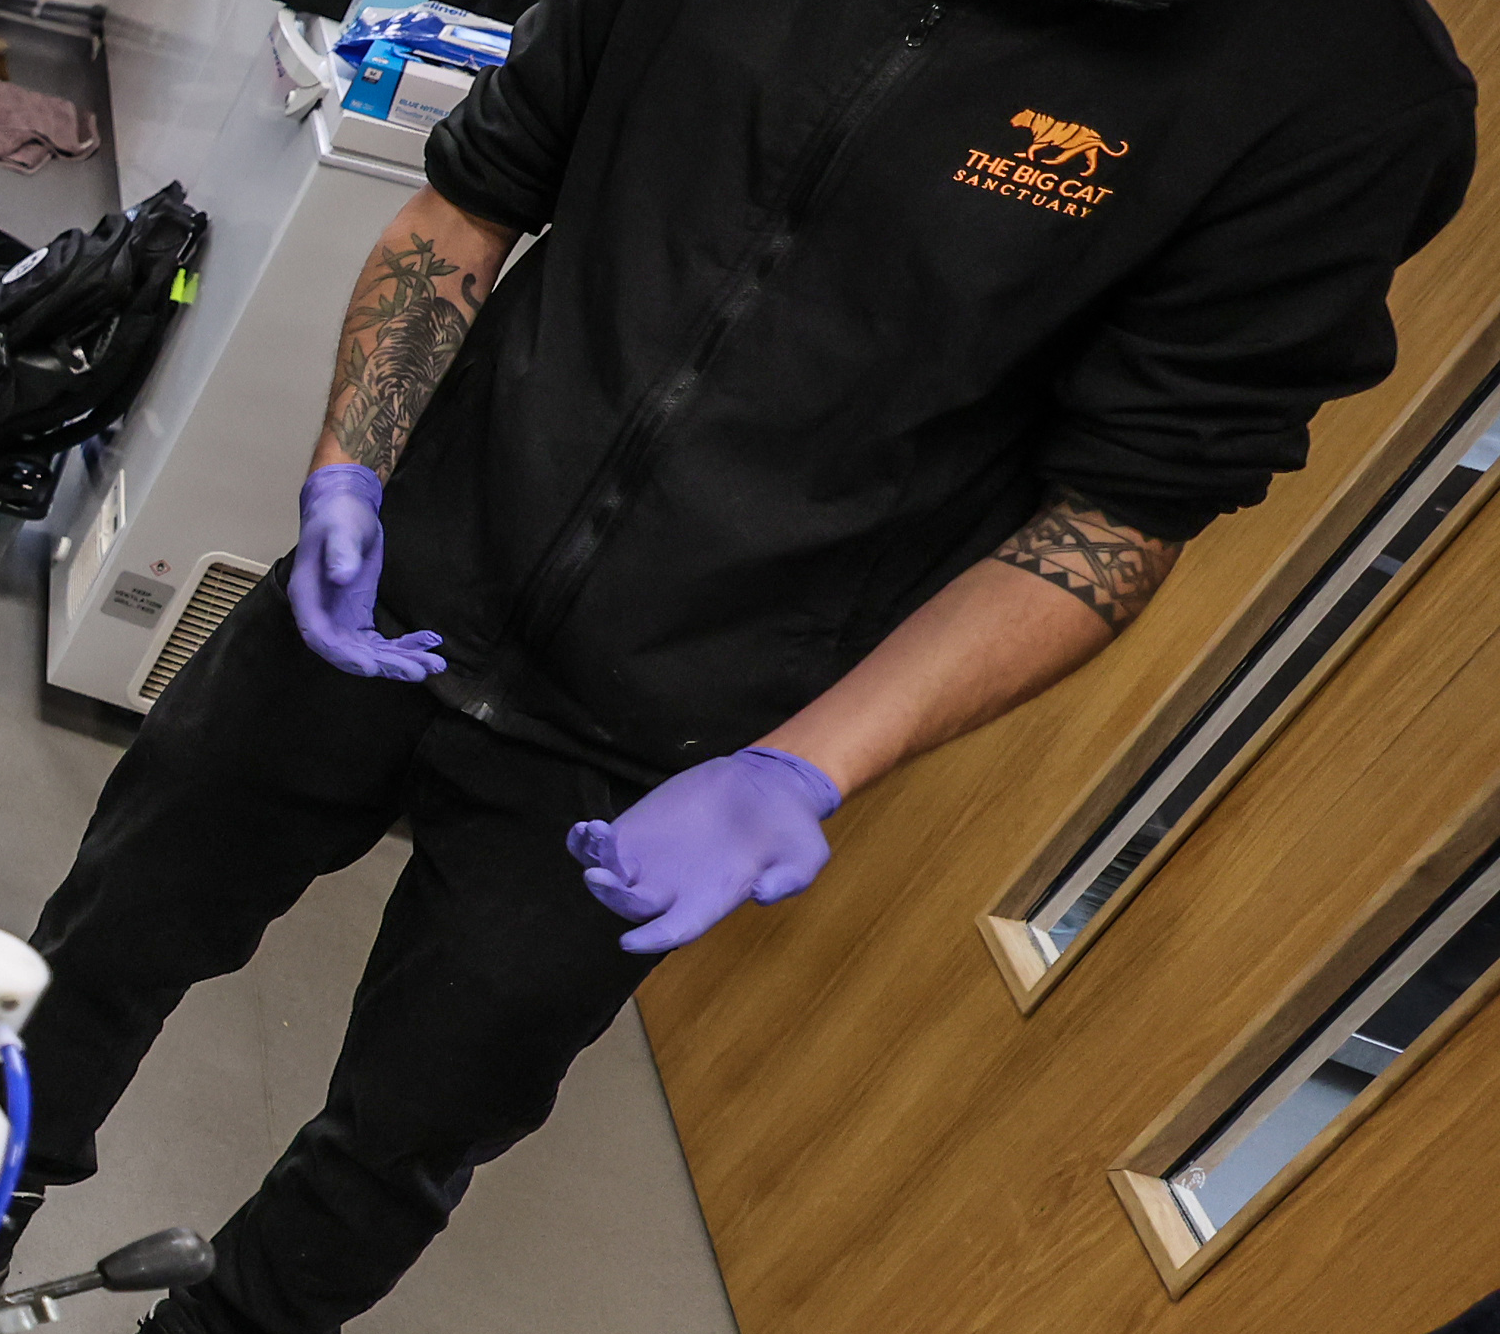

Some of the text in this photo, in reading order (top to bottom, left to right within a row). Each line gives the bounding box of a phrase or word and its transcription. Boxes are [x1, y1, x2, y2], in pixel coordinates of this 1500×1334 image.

[421, 103, 451, 120] NITRIL
[953, 169, 1092, 219] SANCTUARY
[966, 148, 1113, 206] THE BIG CAT
